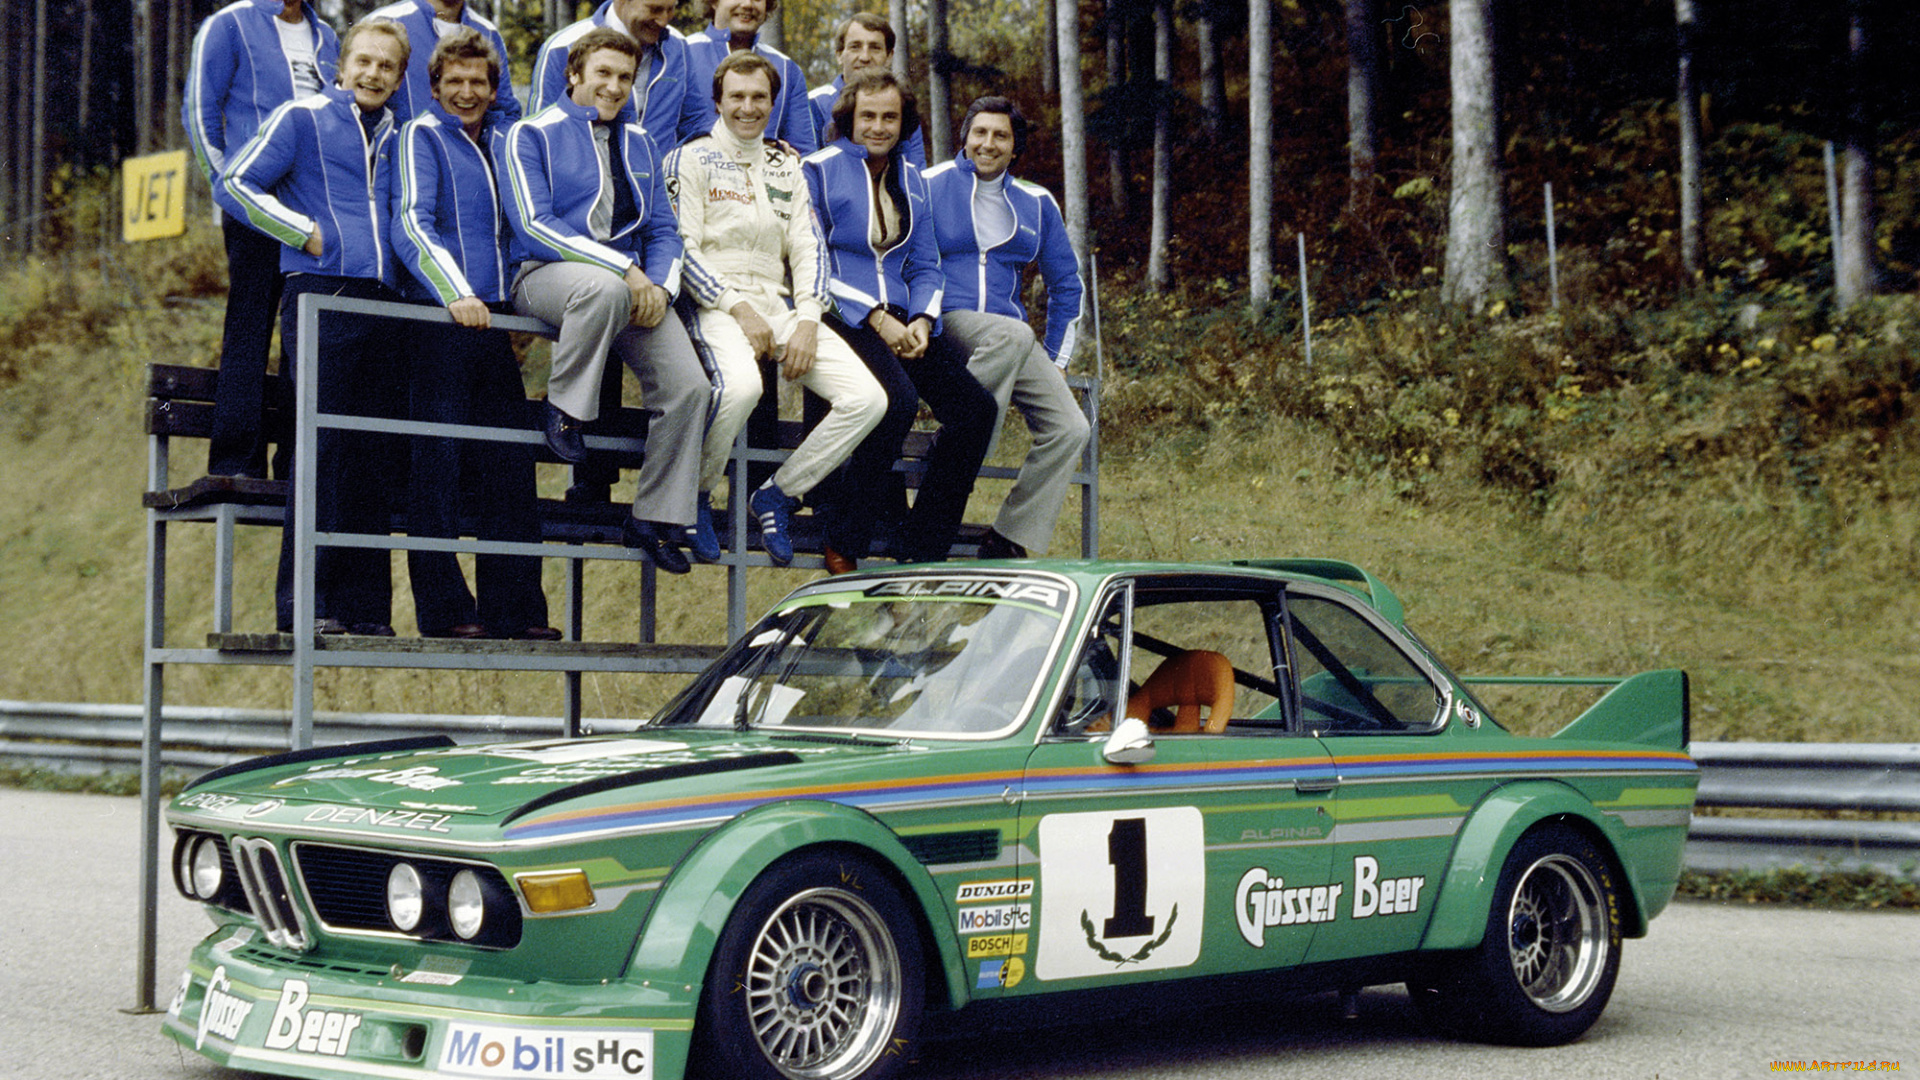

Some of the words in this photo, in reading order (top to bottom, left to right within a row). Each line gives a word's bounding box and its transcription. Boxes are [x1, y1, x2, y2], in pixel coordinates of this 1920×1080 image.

[129, 169, 177, 223] JET
[870, 579, 1060, 608] ALPINA
[303, 806, 454, 834] DENZEL
[1241, 826, 1322, 841] ALPINA
[960, 884, 1031, 898] DUNLOP
[1103, 817, 1155, 939] 1
[1235, 866, 1343, 948] Gösser
[1351, 854, 1426, 919] Beer
[961, 909, 1002, 930] Mobil
[971, 937, 1010, 952] BOSCH
[263, 978, 363, 1057] Beer
[447, 1029, 564, 1072] Mobil
